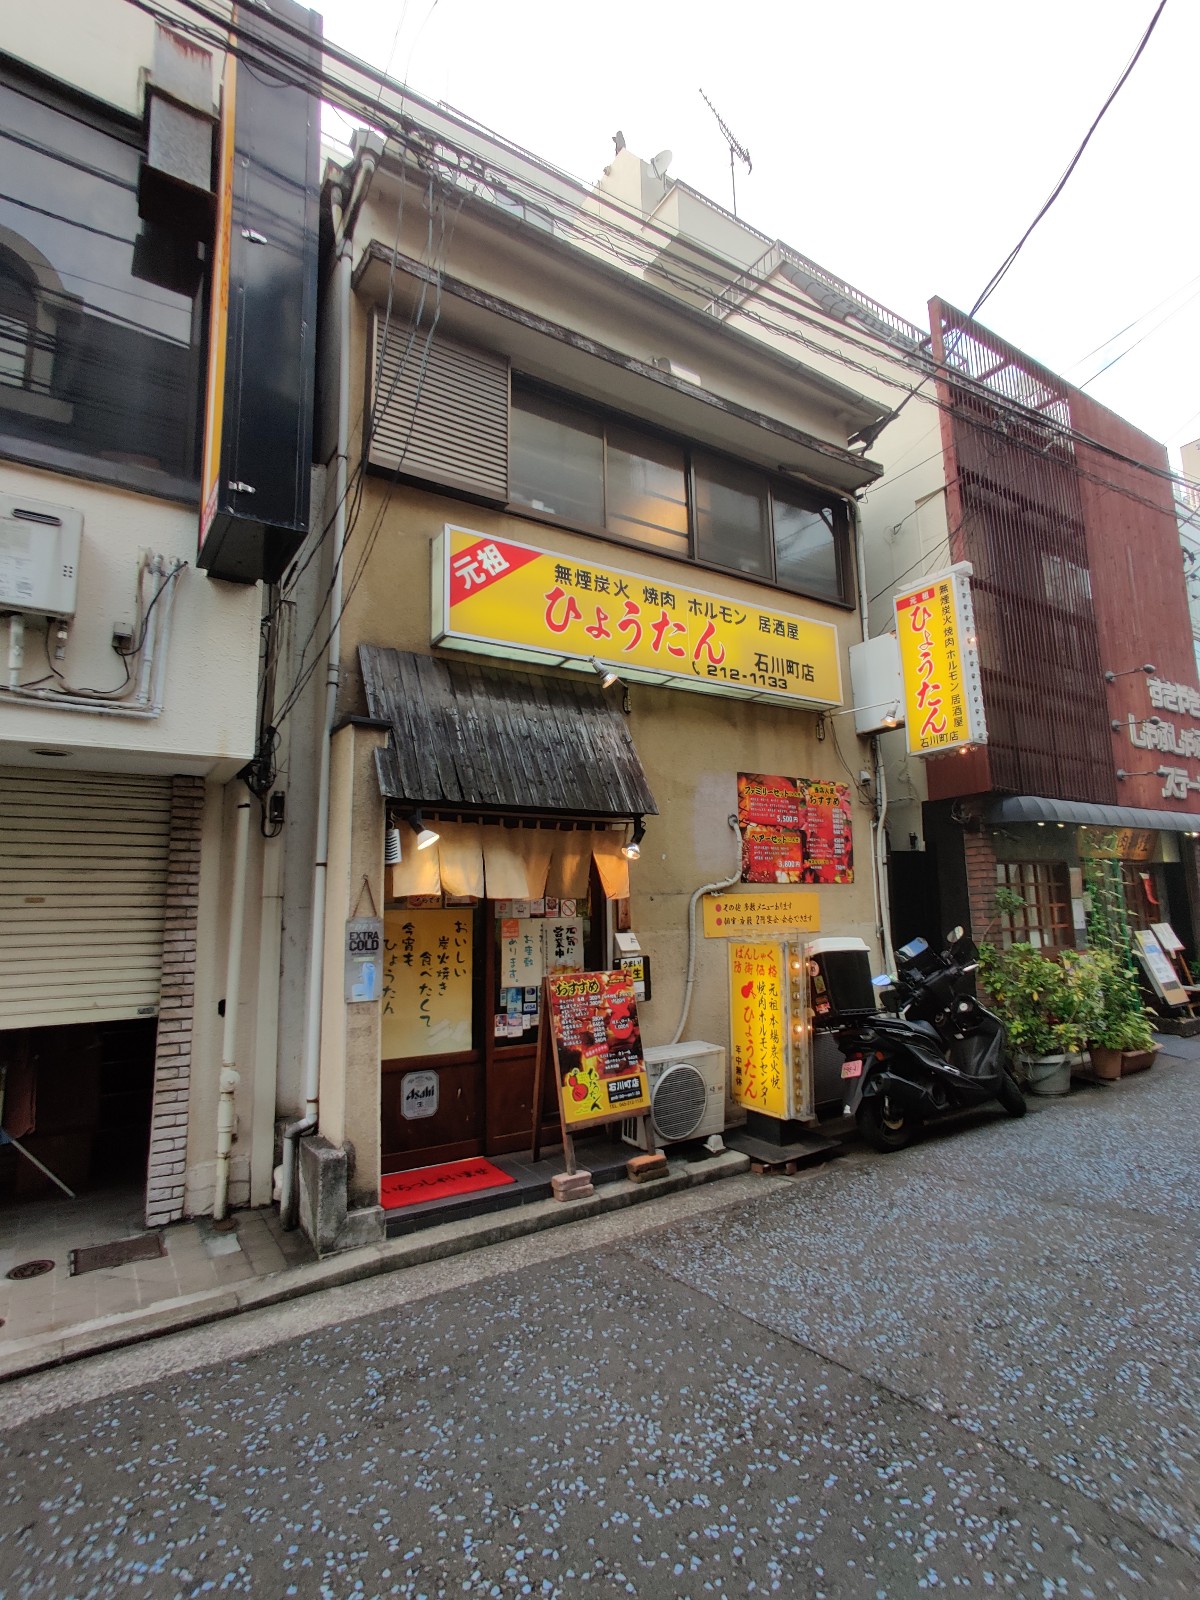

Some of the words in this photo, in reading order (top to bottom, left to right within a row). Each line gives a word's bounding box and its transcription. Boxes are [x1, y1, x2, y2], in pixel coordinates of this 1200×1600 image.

[453, 543, 510, 590] 元祖
[554, 563, 630, 599] 無煙炭火
[643, 586, 676, 611] 焼肉
[687, 597, 747, 625] ホルモン
[758, 615, 800, 641] 居酒屋
[909, 591, 930, 605] 元祖
[939, 583, 953, 625] 無煙炭火
[543, 584, 725, 666] ひょうたん
[944, 626, 954, 647] 焼肉
[707, 664, 788, 690] 212-1133
[754, 651, 815, 683] 石川町店
[910, 605, 946, 737] ひょうたん
[946, 650, 959, 692] ホルモン
[951, 694, 963, 728] 居酒屋
[920, 731, 959, 748] 石川町店
[1159, 765, 1200, 800] ステー
[349, 931, 379, 940] EXTRA
[349, 940, 379, 951] COLD
[402, 922, 415, 967] 今宵も
[455, 921, 467, 977] おいしい
[553, 926, 564, 958] 営業中
[566, 927, 576, 954] 元気に
[383, 939, 397, 1015] ひょうたん
[437, 935, 449, 996] 炭火焼き
[419, 952, 433, 1027] 食べたくて
[556, 980, 599, 996] おすすめ
[743, 1006, 757, 1099] ひょうたん
[406, 1085, 434, 1100] Asahi
[608, 1078, 639, 1092] 石川町店
